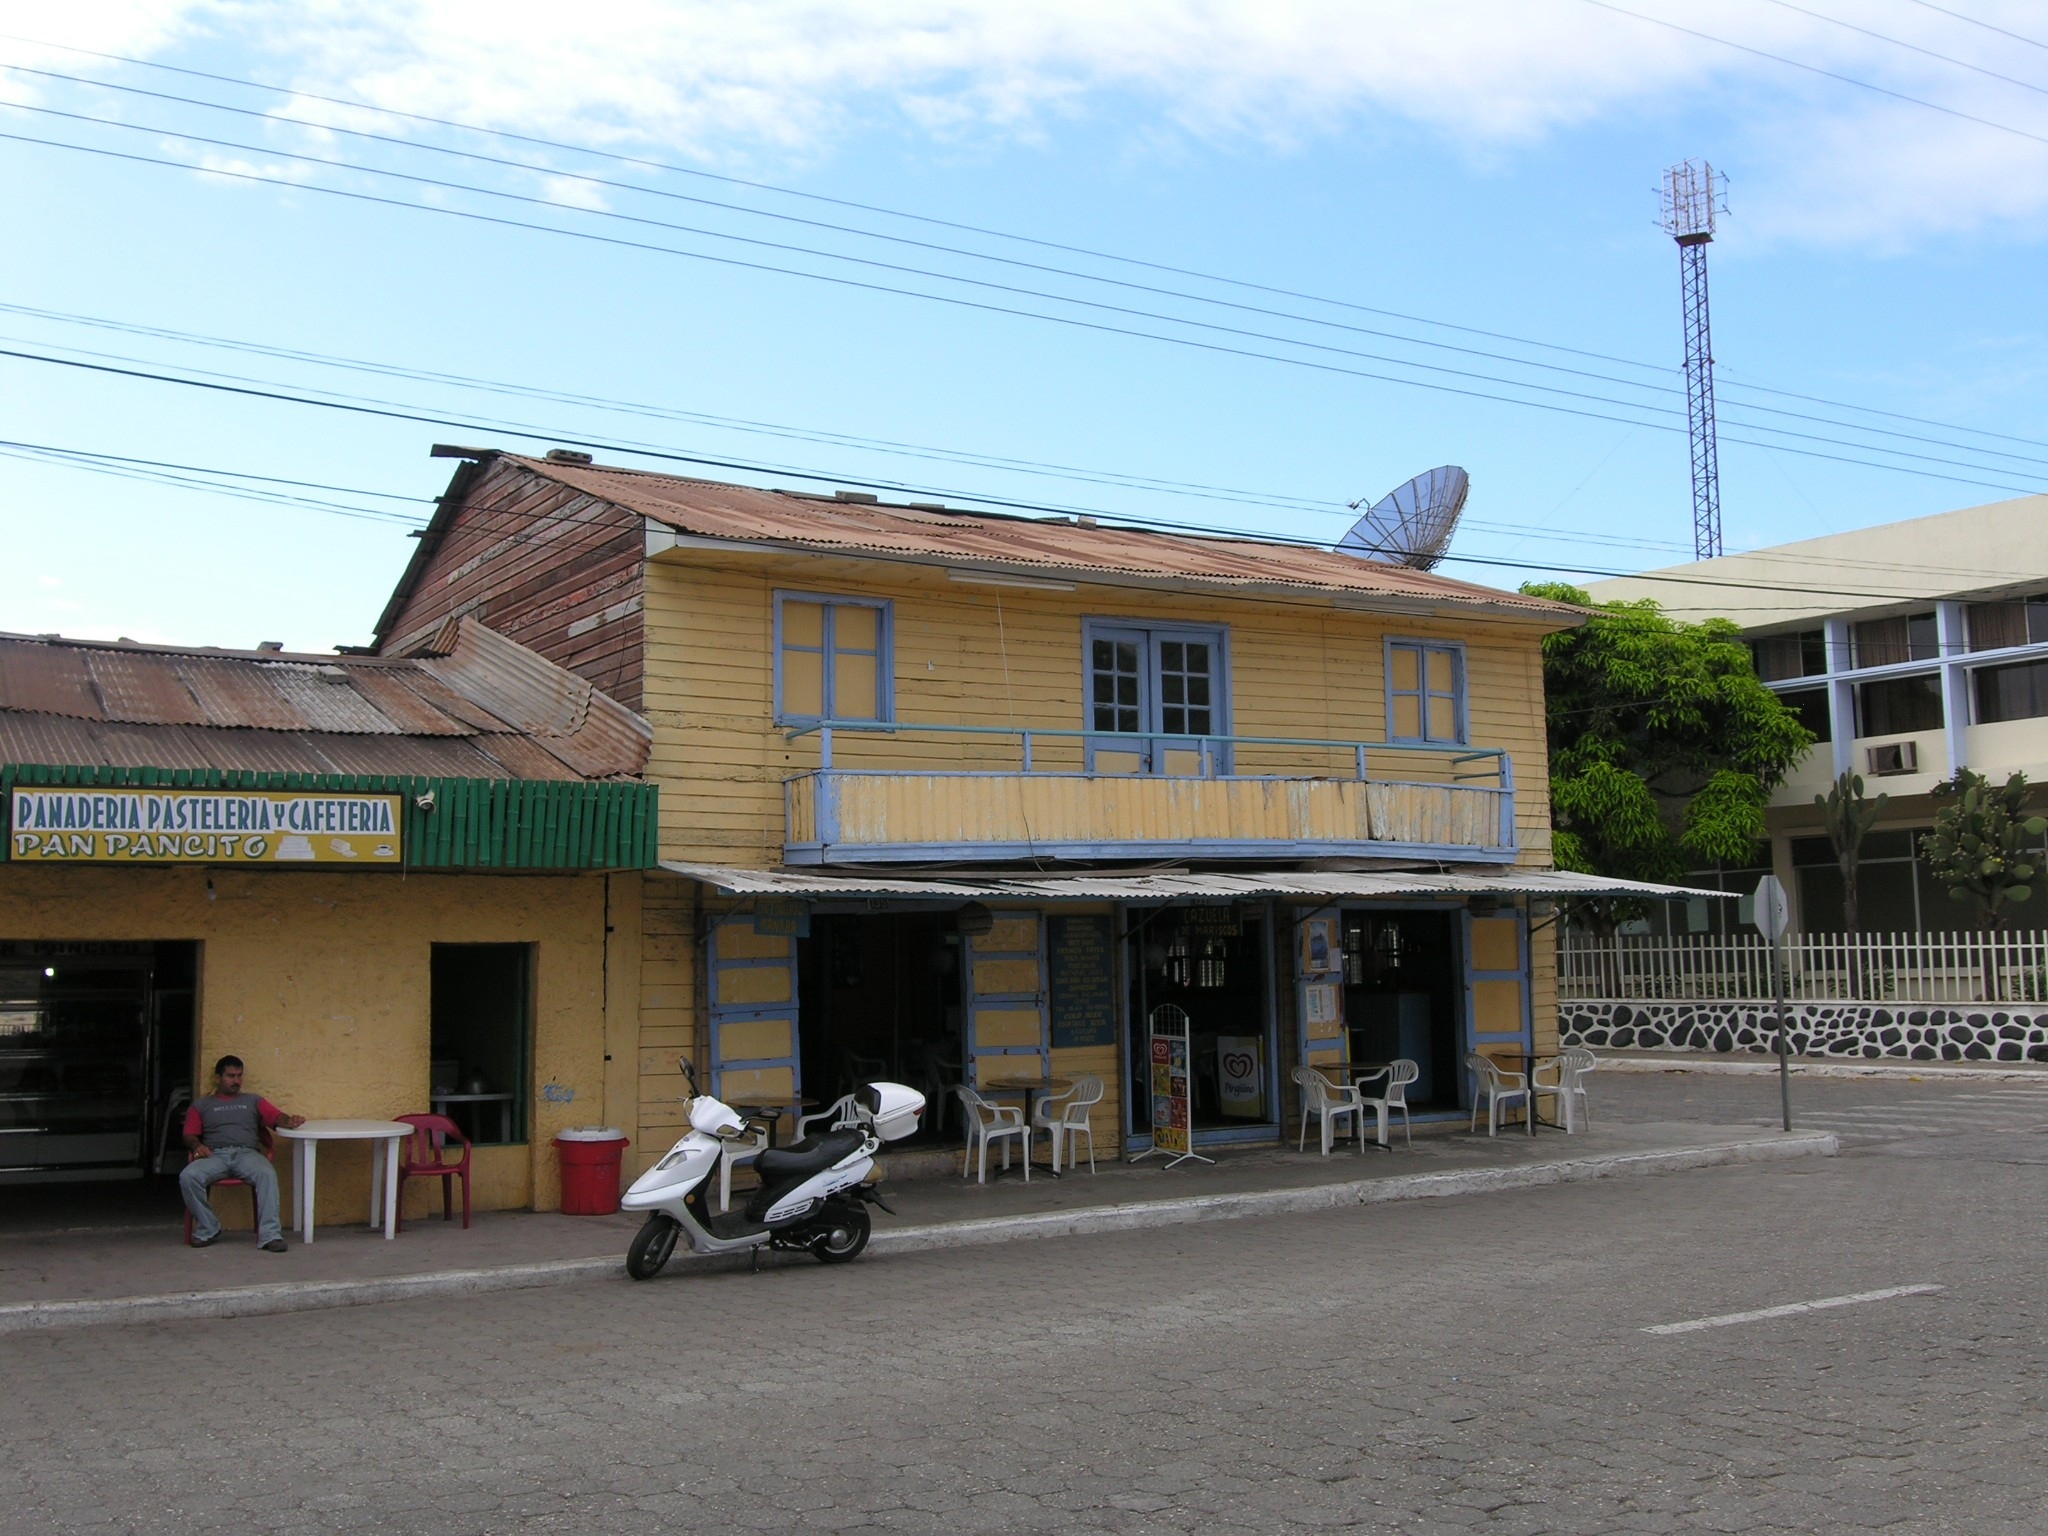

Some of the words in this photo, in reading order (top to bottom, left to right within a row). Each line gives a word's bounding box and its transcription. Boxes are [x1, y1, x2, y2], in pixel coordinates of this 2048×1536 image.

[17, 794, 142, 830] PANADERIA
[147, 796, 271, 831] PASTELERIA
[288, 798, 392, 833] CAFETERIA
[14, 833, 95, 857] PAN
[104, 834, 267, 859] PANCITO
[1184, 906, 1230, 924] CAZUELA
[1195, 924, 1238, 937] MARISCOS
